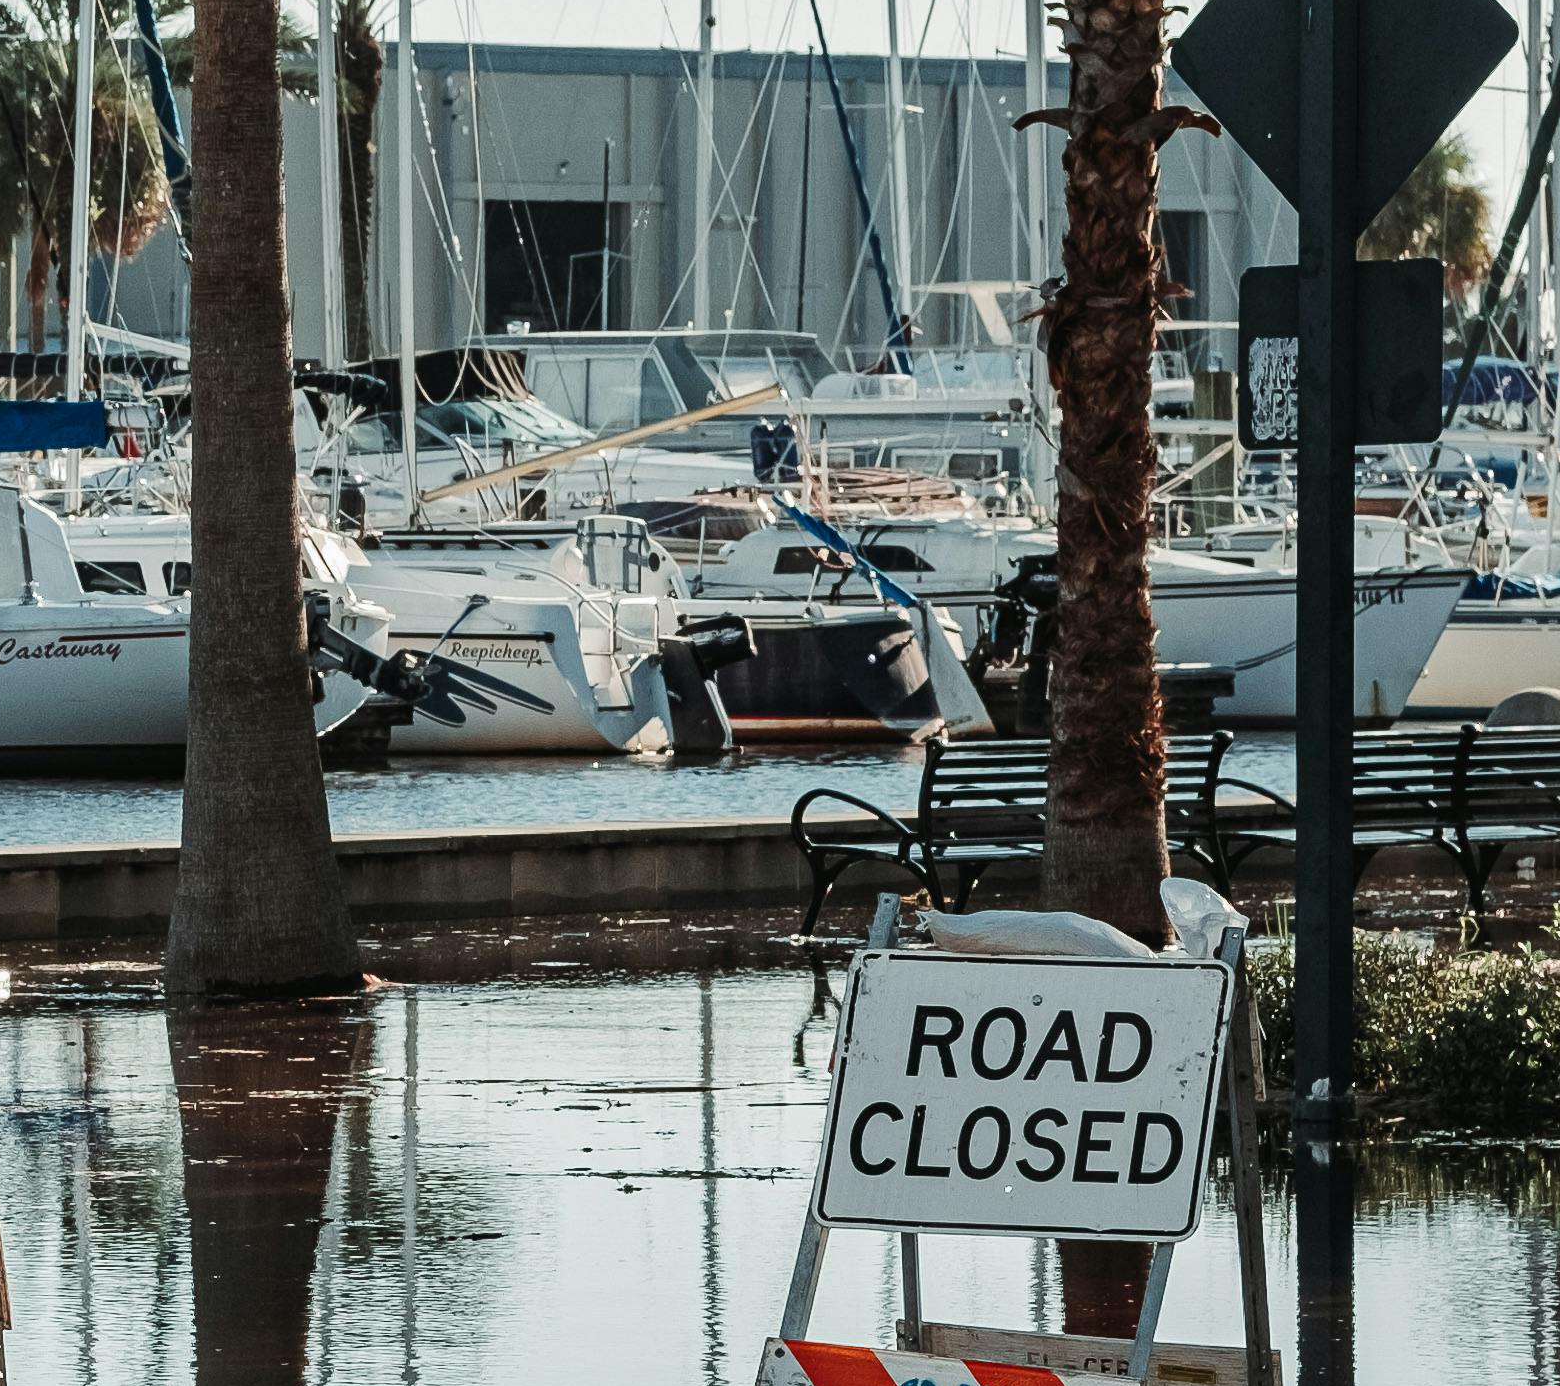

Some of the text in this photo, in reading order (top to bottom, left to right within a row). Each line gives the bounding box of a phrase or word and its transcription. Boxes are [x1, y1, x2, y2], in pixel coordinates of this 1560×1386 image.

[448, 642, 540, 668] Reepicheep
[905, 1004, 1154, 1084] ROAD
[849, 1101, 1185, 1186] CLOSED
